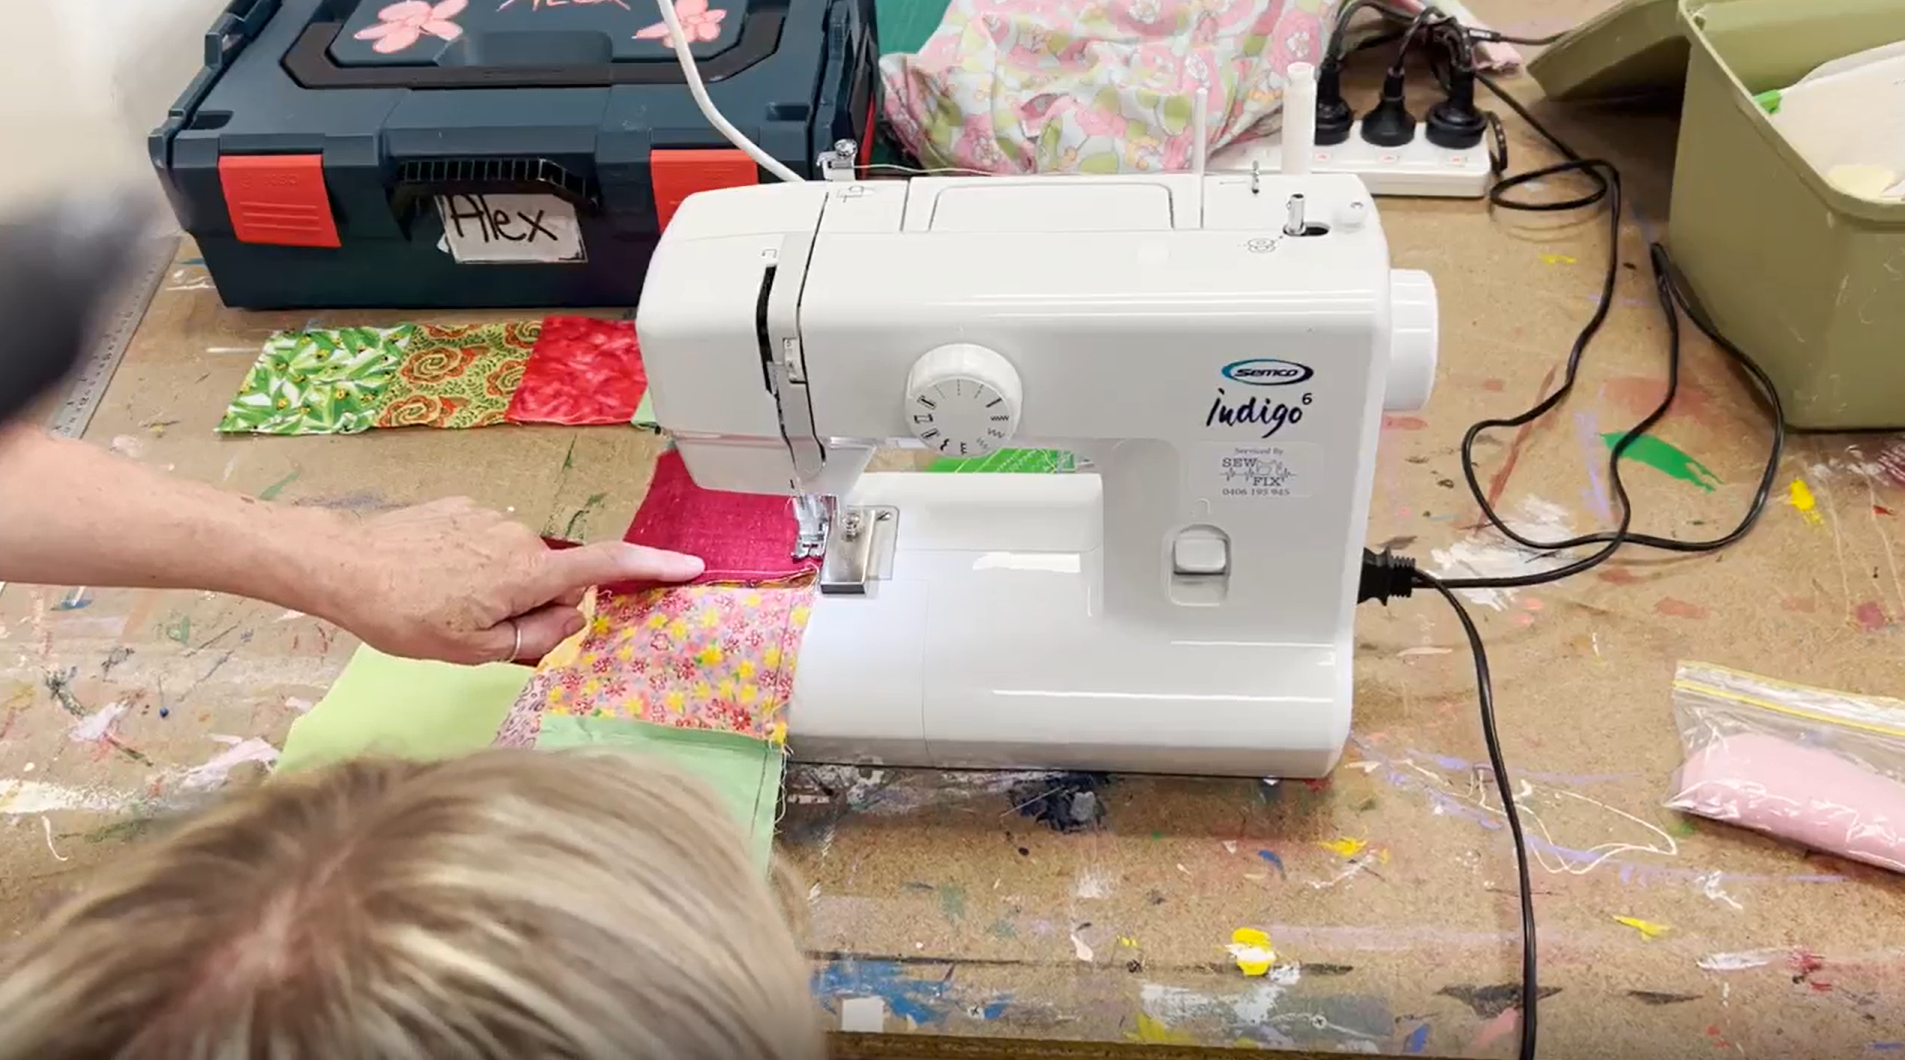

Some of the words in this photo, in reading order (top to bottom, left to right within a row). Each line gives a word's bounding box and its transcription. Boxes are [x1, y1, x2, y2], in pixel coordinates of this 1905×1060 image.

[449, 193, 558, 243] Alex
[1222, 457, 1258, 468] SEW
[1252, 476, 1282, 487] FIX
[1222, 488, 1248, 496] 0406
